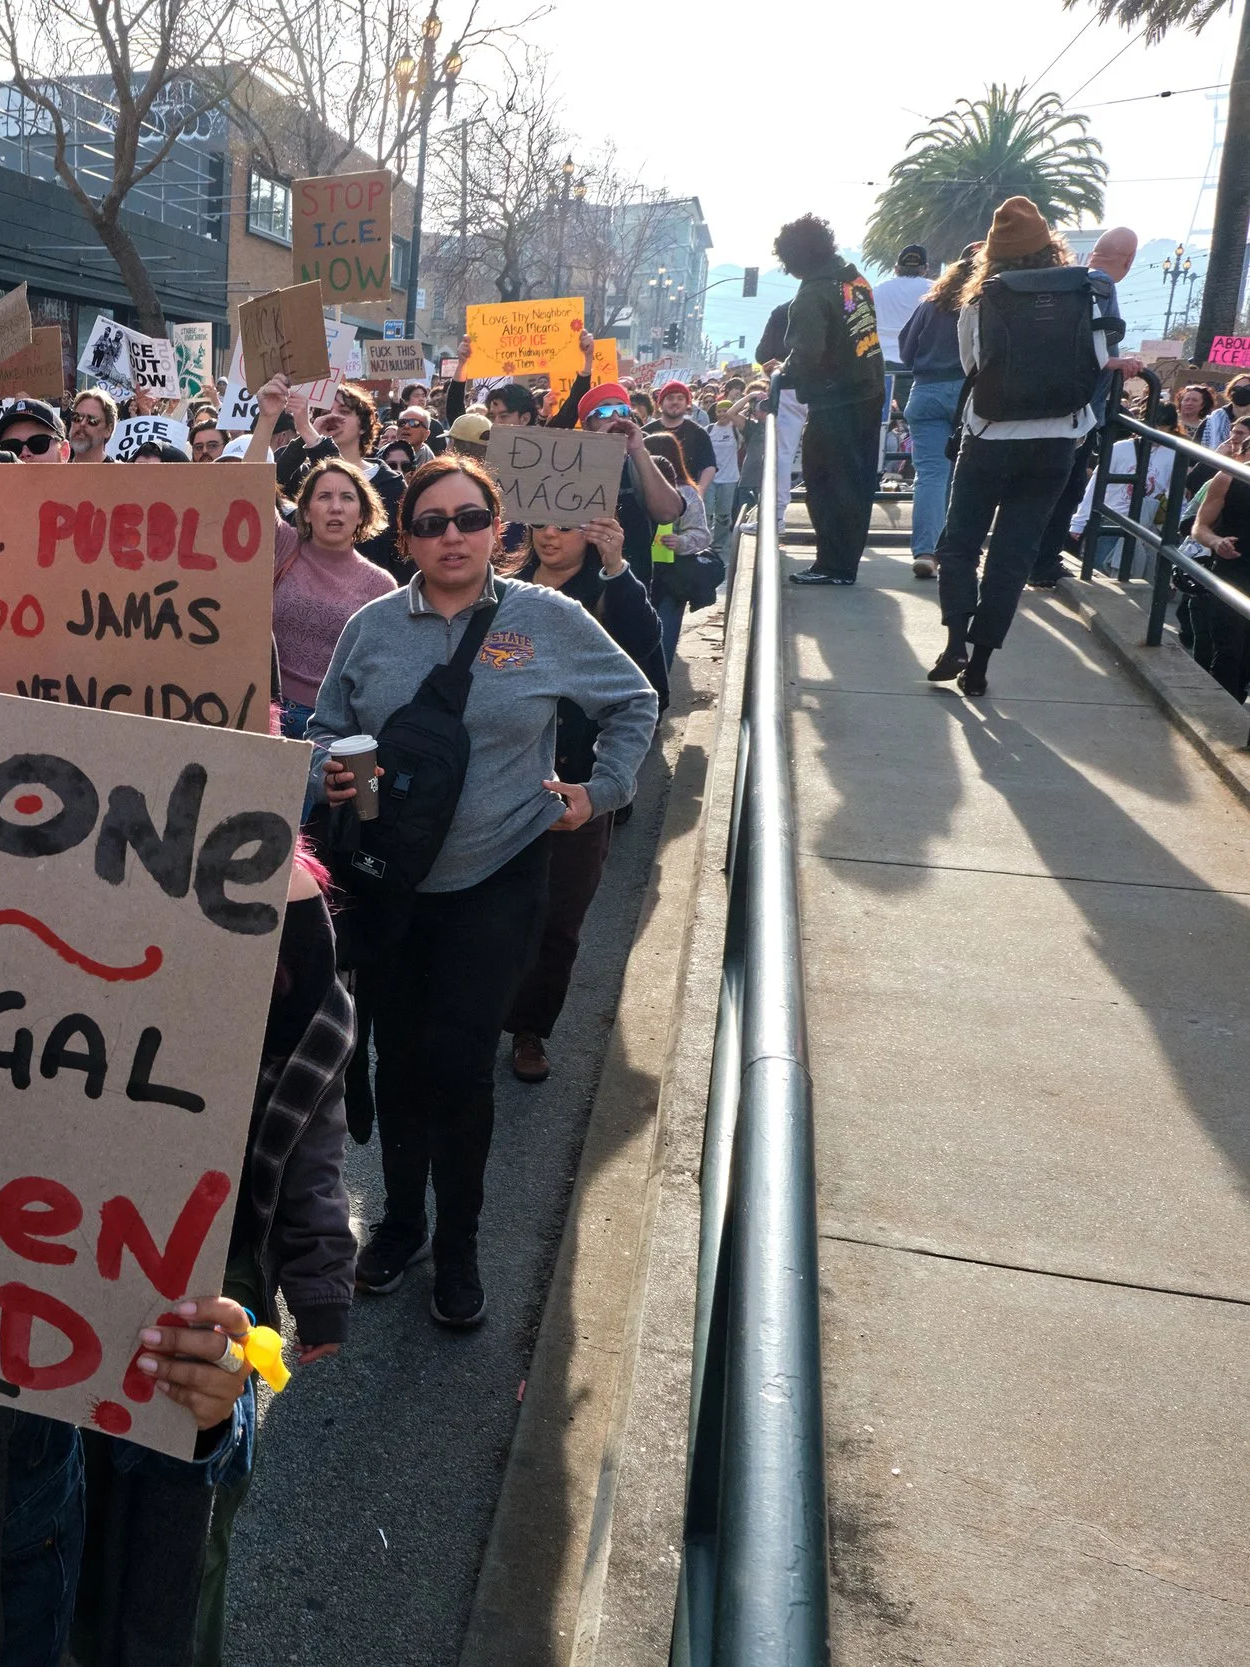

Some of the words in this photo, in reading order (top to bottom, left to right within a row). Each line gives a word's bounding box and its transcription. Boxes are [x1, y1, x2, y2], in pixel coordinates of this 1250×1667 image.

[301, 181, 385, 217] STOP
[312, 219, 382, 248] I.C.E.
[301, 253, 390, 292] NOW
[482, 313, 508, 326] Love
[511, 311, 530, 323] Thy
[532, 307, 573, 322] Neighbor
[501, 325, 524, 336] Also
[526, 322, 560, 334] Means
[500, 335, 528, 347] STOP
[530, 334, 547, 345] ICE
[370, 346, 391, 358] FUCK
[397, 345, 416, 357] THIS
[495, 347, 517, 359] From
[1210, 349, 1241, 363] ICE
[370, 359, 389, 373] NAZI
[389, 358, 424, 371] BULLSHIT!
[125, 421, 169, 436] ICE
[37, 499, 262, 571] PUEBLO
[66, 580, 221, 645] JAMÁS
